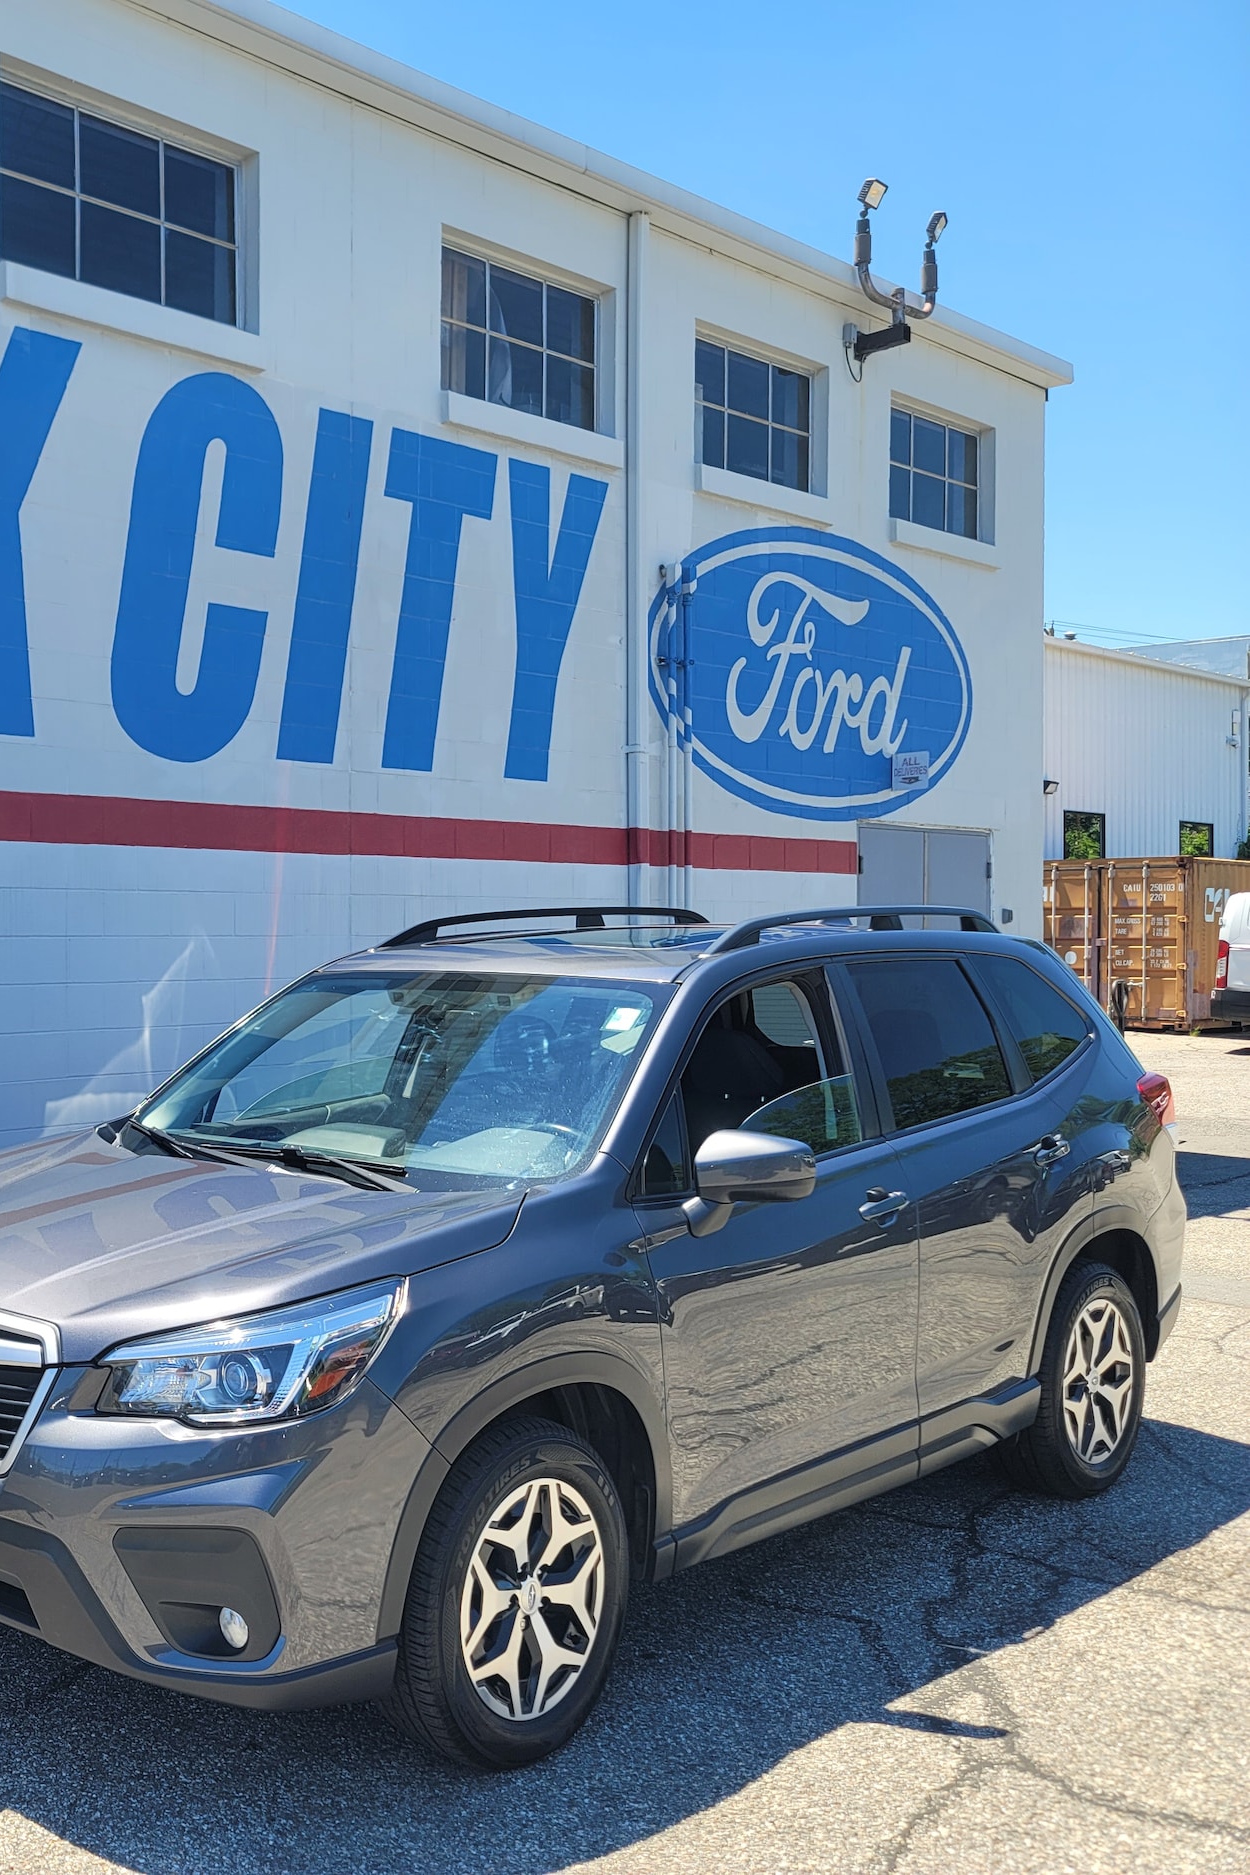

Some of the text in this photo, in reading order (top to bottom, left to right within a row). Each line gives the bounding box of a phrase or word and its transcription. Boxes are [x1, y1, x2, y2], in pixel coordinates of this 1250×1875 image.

[110, 371, 609, 782] CITY
[726, 571, 912, 758] Ford
[902, 757, 920, 767] ALL
[1150, 883, 1176, 892] 250103
[1204, 887, 1230, 923] CA
[1114, 927, 1128, 935] TARE
[455, 1454, 531, 1569] TOYO TIRES
